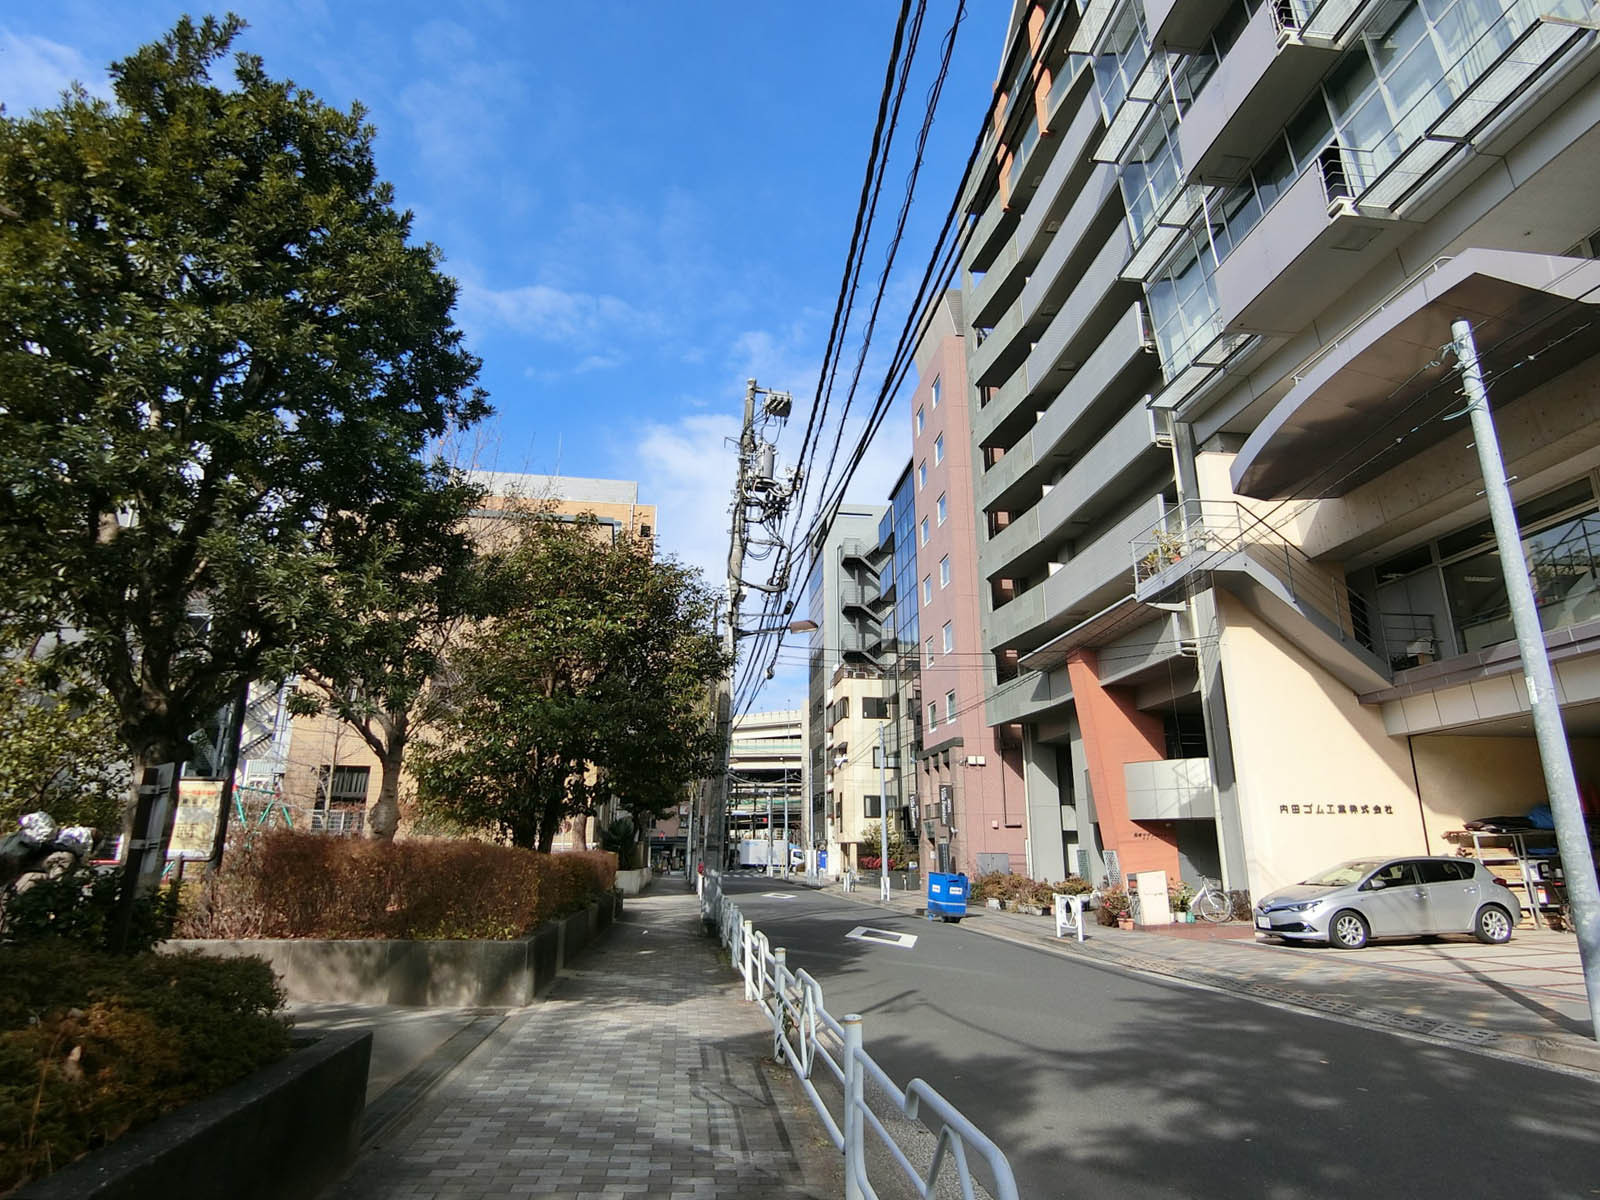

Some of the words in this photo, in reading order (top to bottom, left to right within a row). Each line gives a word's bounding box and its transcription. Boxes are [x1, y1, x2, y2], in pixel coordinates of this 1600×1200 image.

[1279, 803, 1394, 815] 内田ゴム工業株式会社
